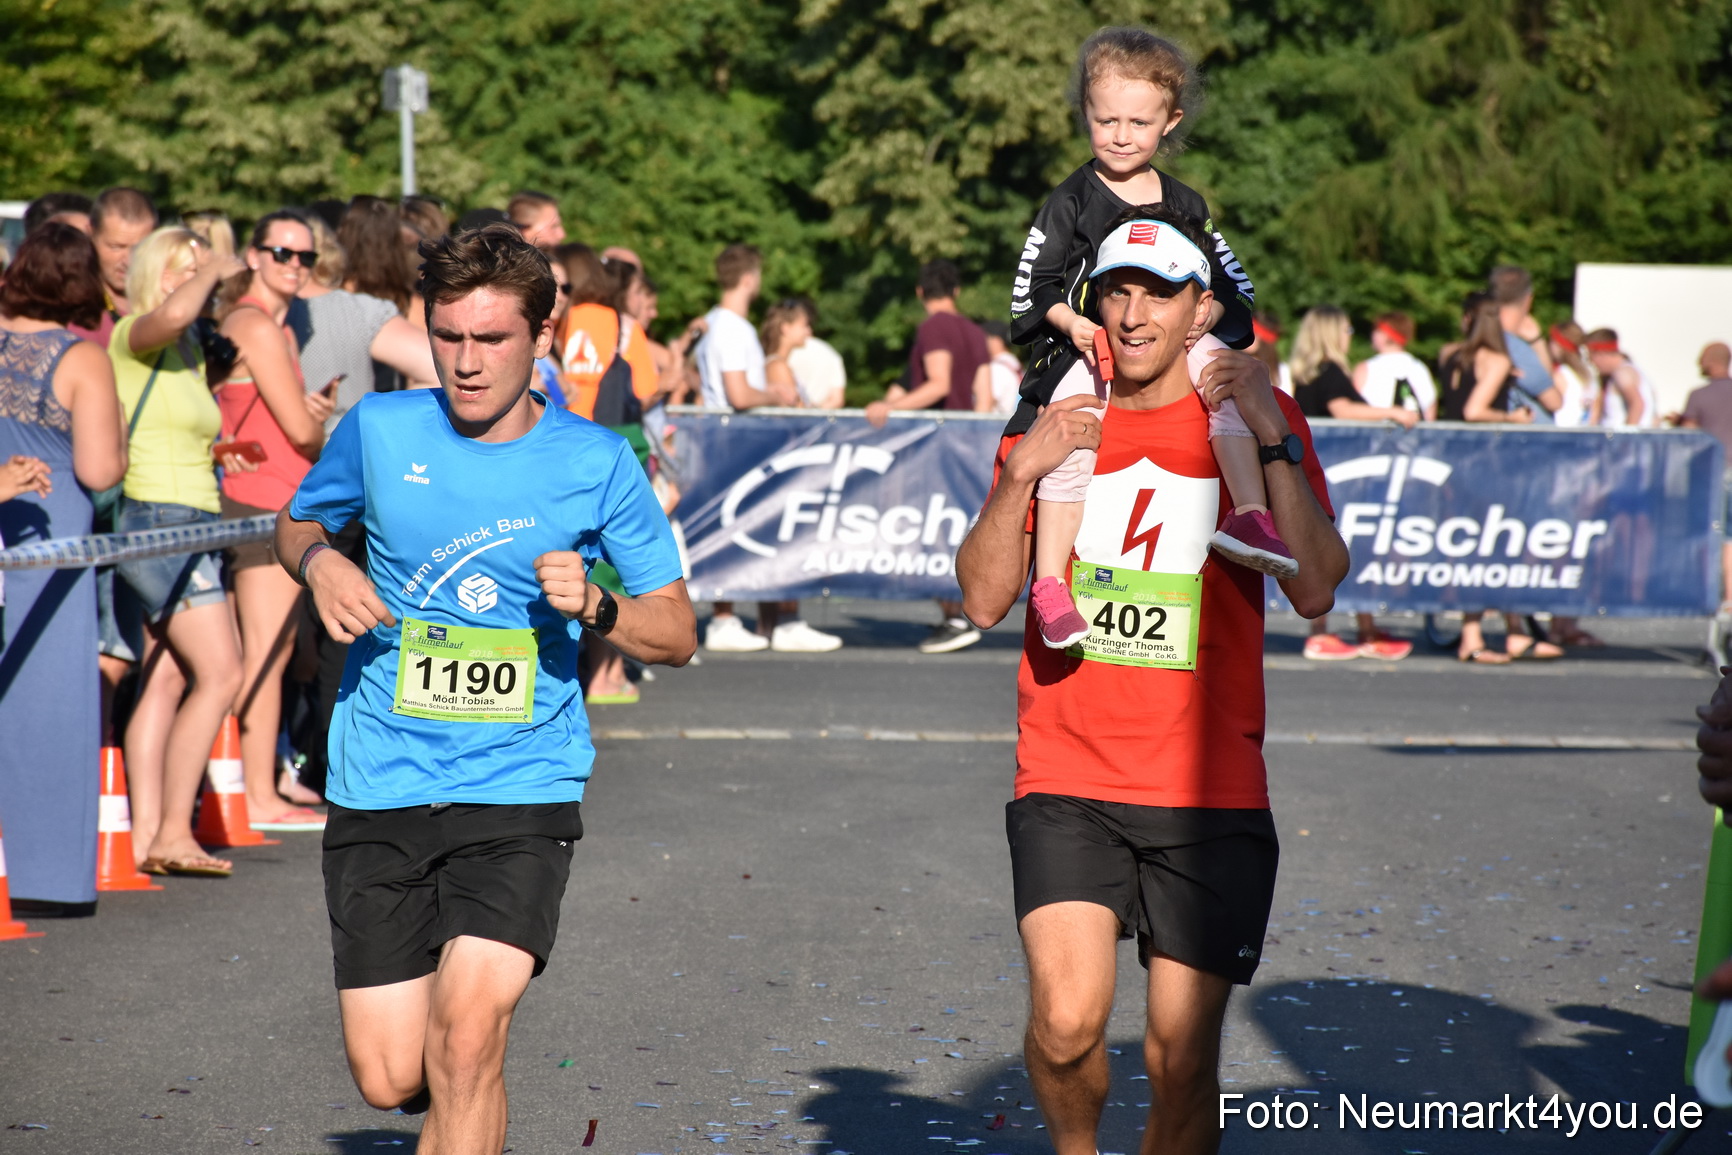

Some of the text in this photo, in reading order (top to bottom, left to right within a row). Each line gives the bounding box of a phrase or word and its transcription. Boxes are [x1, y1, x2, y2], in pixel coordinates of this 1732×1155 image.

[403, 473, 430, 485] erima
[777, 491, 981, 546] Fisch
[1338, 503, 1608, 560] Fischer
[401, 516, 536, 598] Team Schick Bau
[1356, 561, 1584, 590] AUTOMOBILE
[1087, 577, 1129, 592] firmenlauf
[1092, 602, 1167, 640] 402
[418, 635, 464, 650] firmenlauf
[1085, 635, 1174, 652] Kürzinger Thomas
[1129, 650, 1150, 658] GmbH
[415, 656, 517, 695] 1190
[401, 698, 428, 708] Matthias
[428, 703, 450, 711] Schick
[432, 693, 495, 705] Mödl Tobias
